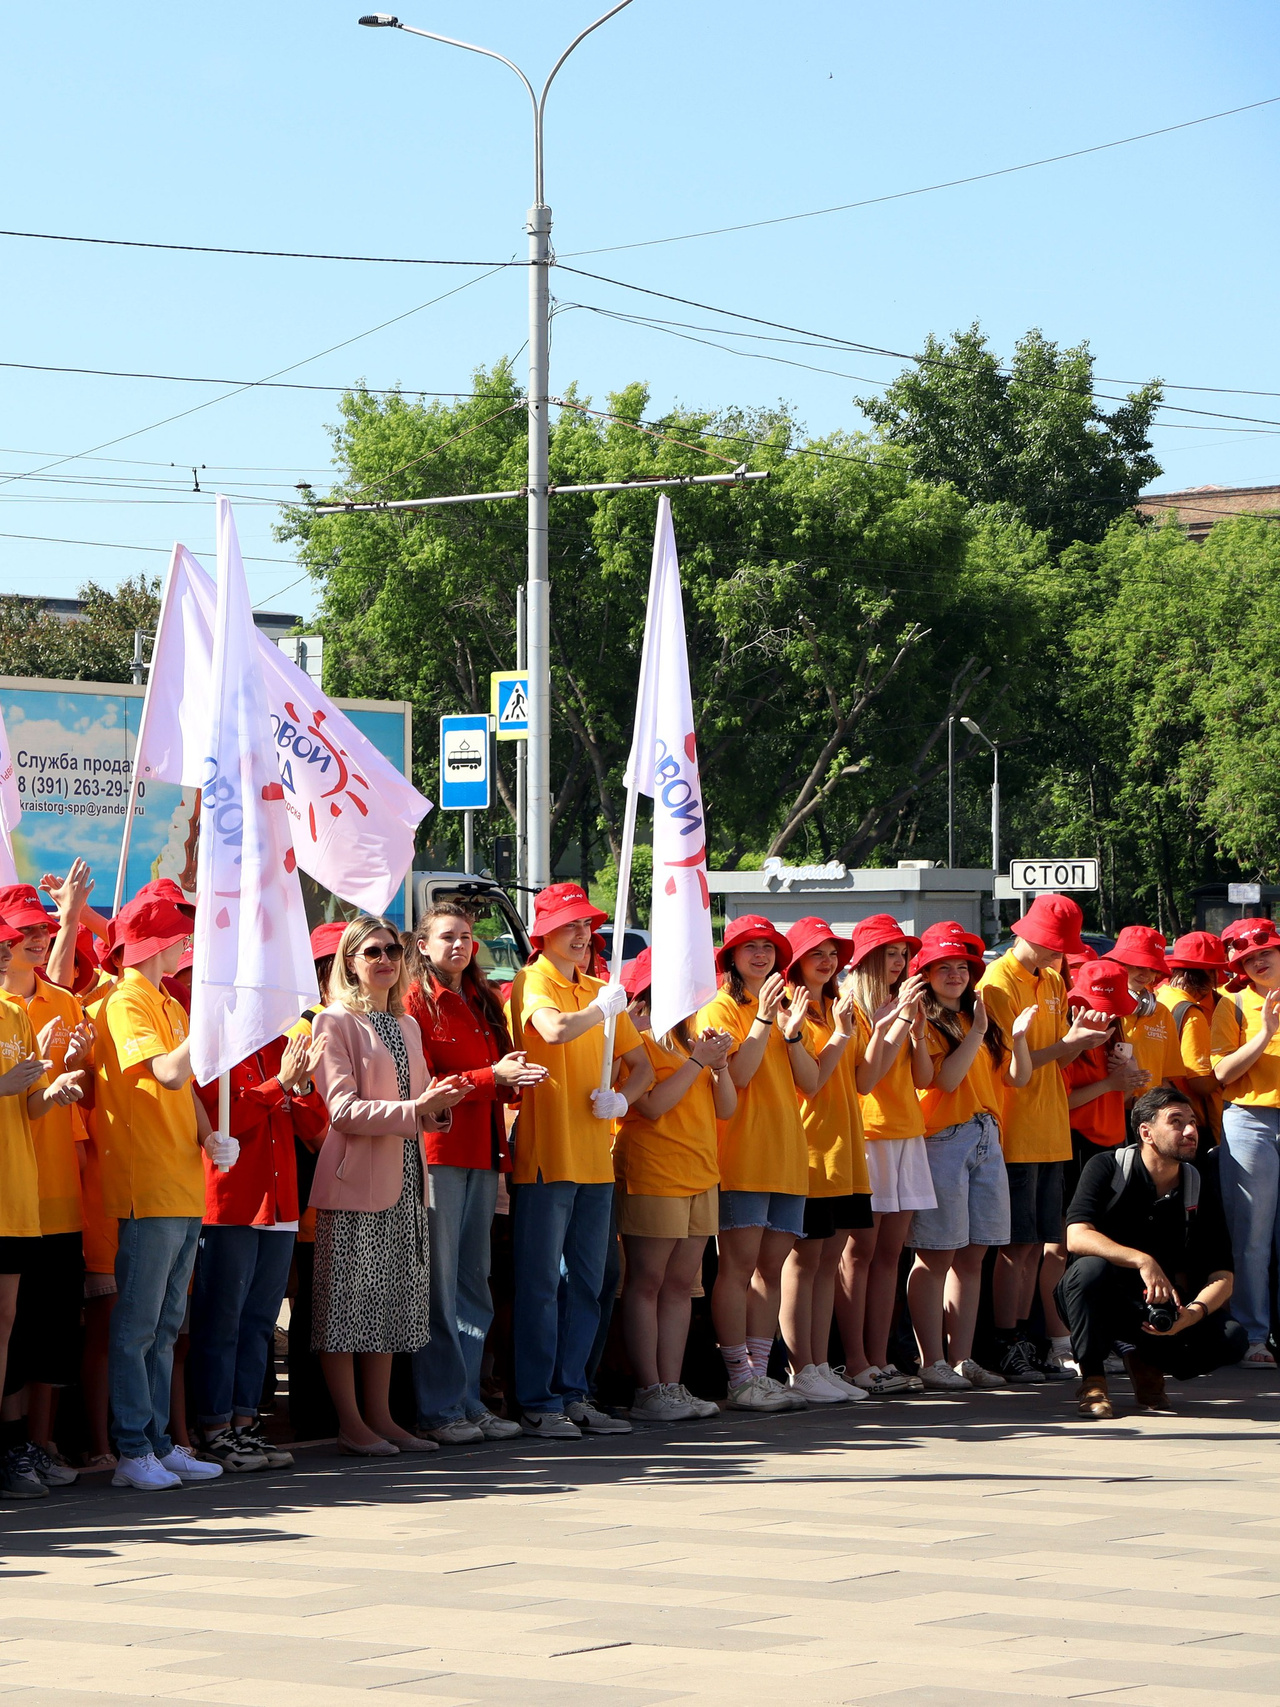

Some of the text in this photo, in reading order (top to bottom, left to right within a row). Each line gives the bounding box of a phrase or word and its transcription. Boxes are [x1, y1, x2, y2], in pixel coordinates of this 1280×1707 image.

[17, 750, 78, 773] Служба
[83, 758, 134, 776] прода
[18, 776, 146, 799] 8 (391) 263-29-0
[1023, 865, 1085, 886] СТОП
